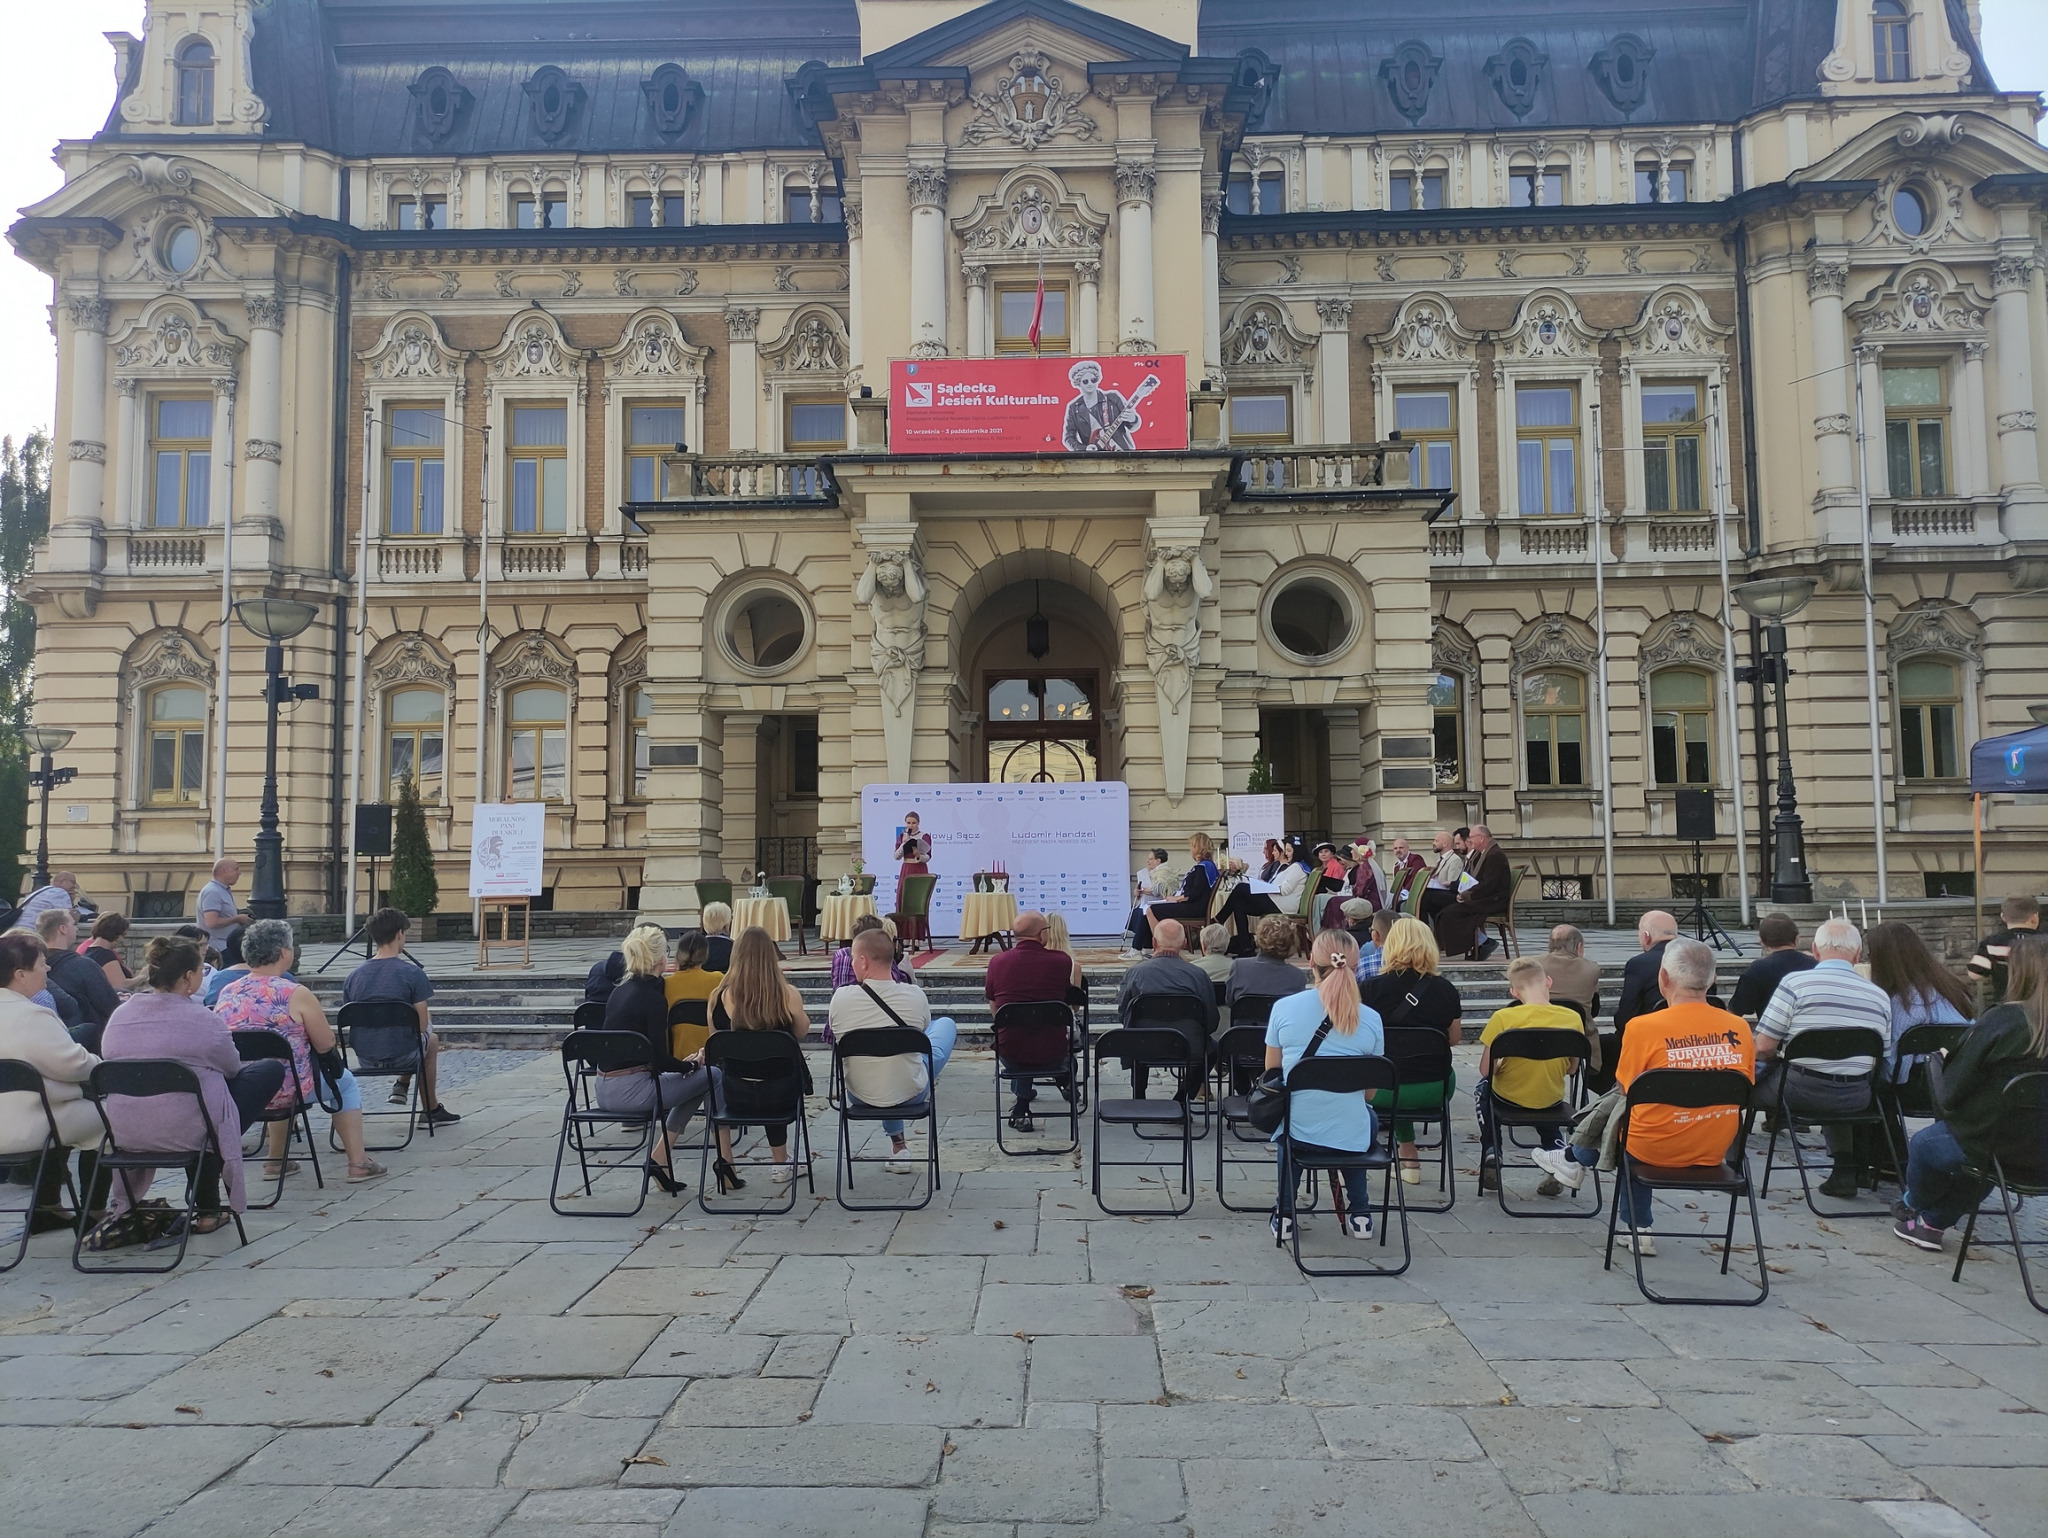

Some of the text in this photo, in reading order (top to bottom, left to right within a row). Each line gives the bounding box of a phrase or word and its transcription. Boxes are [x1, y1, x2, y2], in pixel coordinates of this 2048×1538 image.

[937, 383, 996, 396] Sądecka
[937, 394, 1060, 407] Jesień Kulturalna
[929, 831, 980, 841] owy Sącz
[1011, 830, 1096, 839] Ludomir Handzel
[1667, 1046, 1732, 1060] SURVIVAL
[1692, 1053, 1743, 1068] FITTEST
